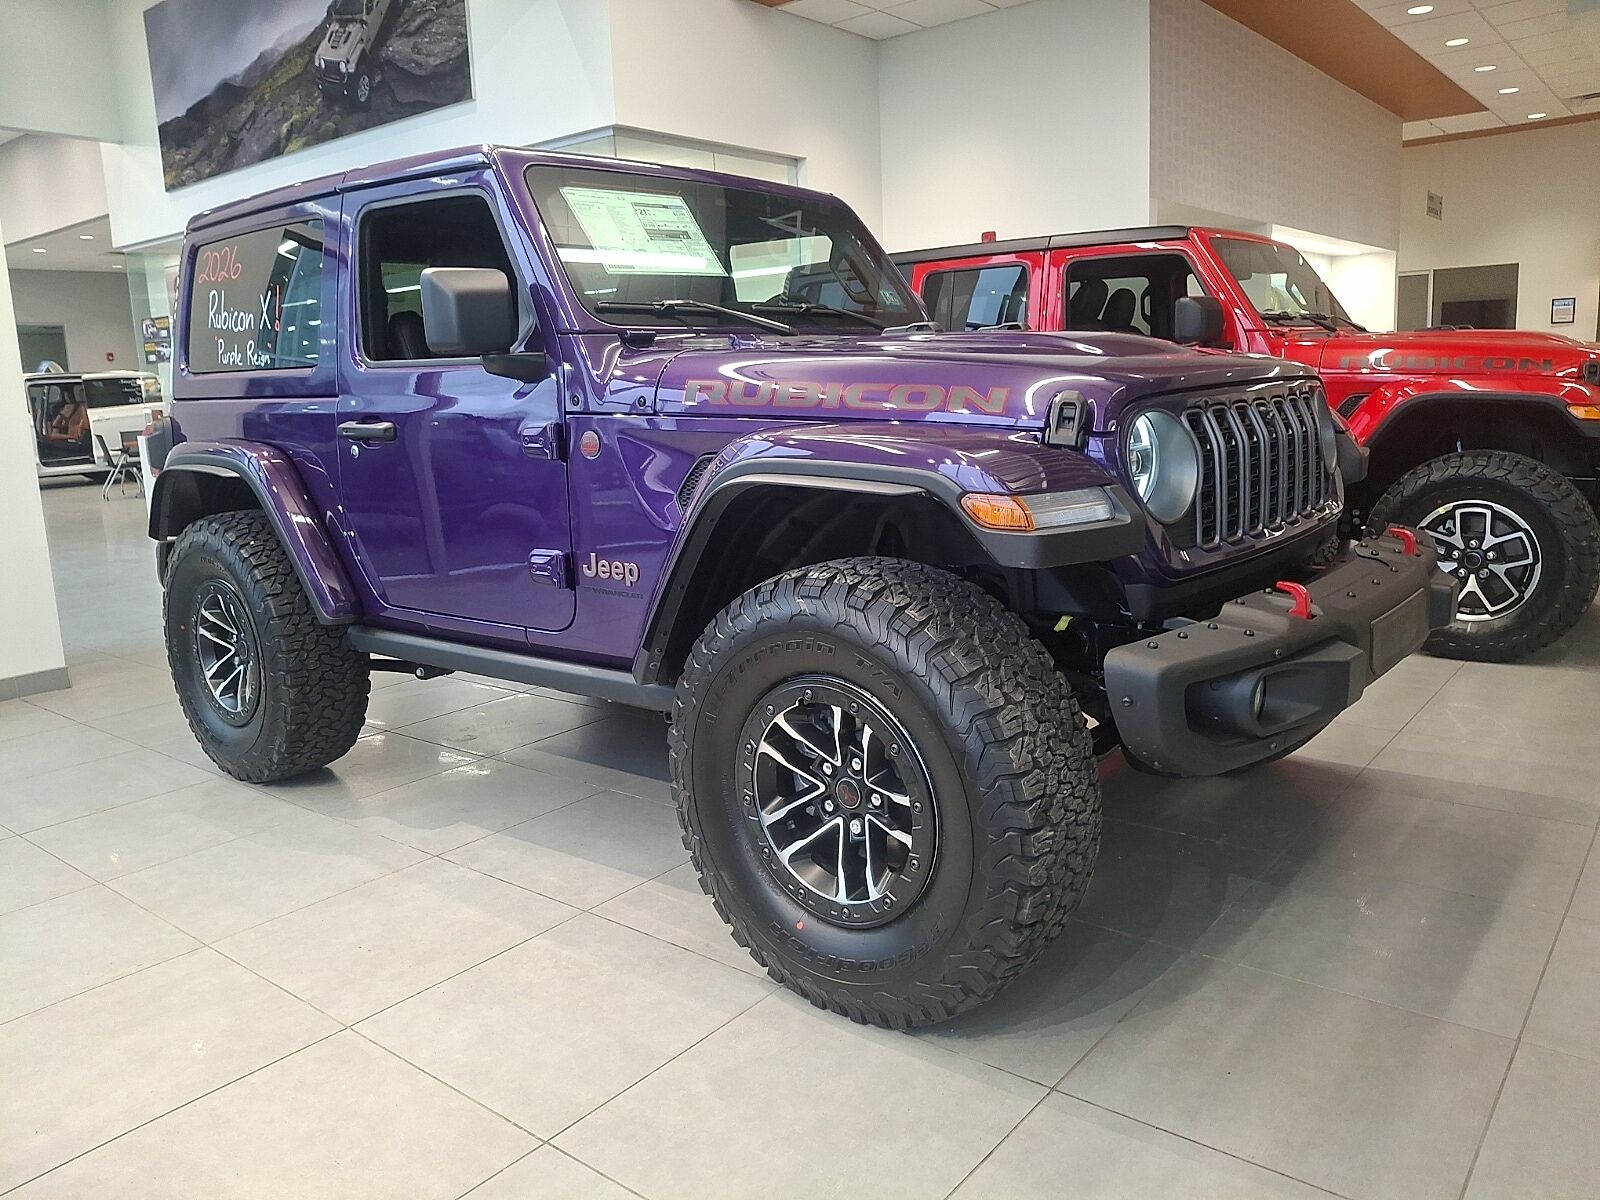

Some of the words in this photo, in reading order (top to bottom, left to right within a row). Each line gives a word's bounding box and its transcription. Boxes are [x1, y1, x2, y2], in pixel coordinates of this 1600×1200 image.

[198, 245, 242, 283] 2026
[208, 289, 255, 333] Rubicon
[217, 338, 243, 366] Purple
[246, 339, 271, 367] Reign
[1339, 353, 1554, 372] RUBICON
[683, 379, 1010, 414] RUBICON
[582, 552, 640, 587] Jeep
